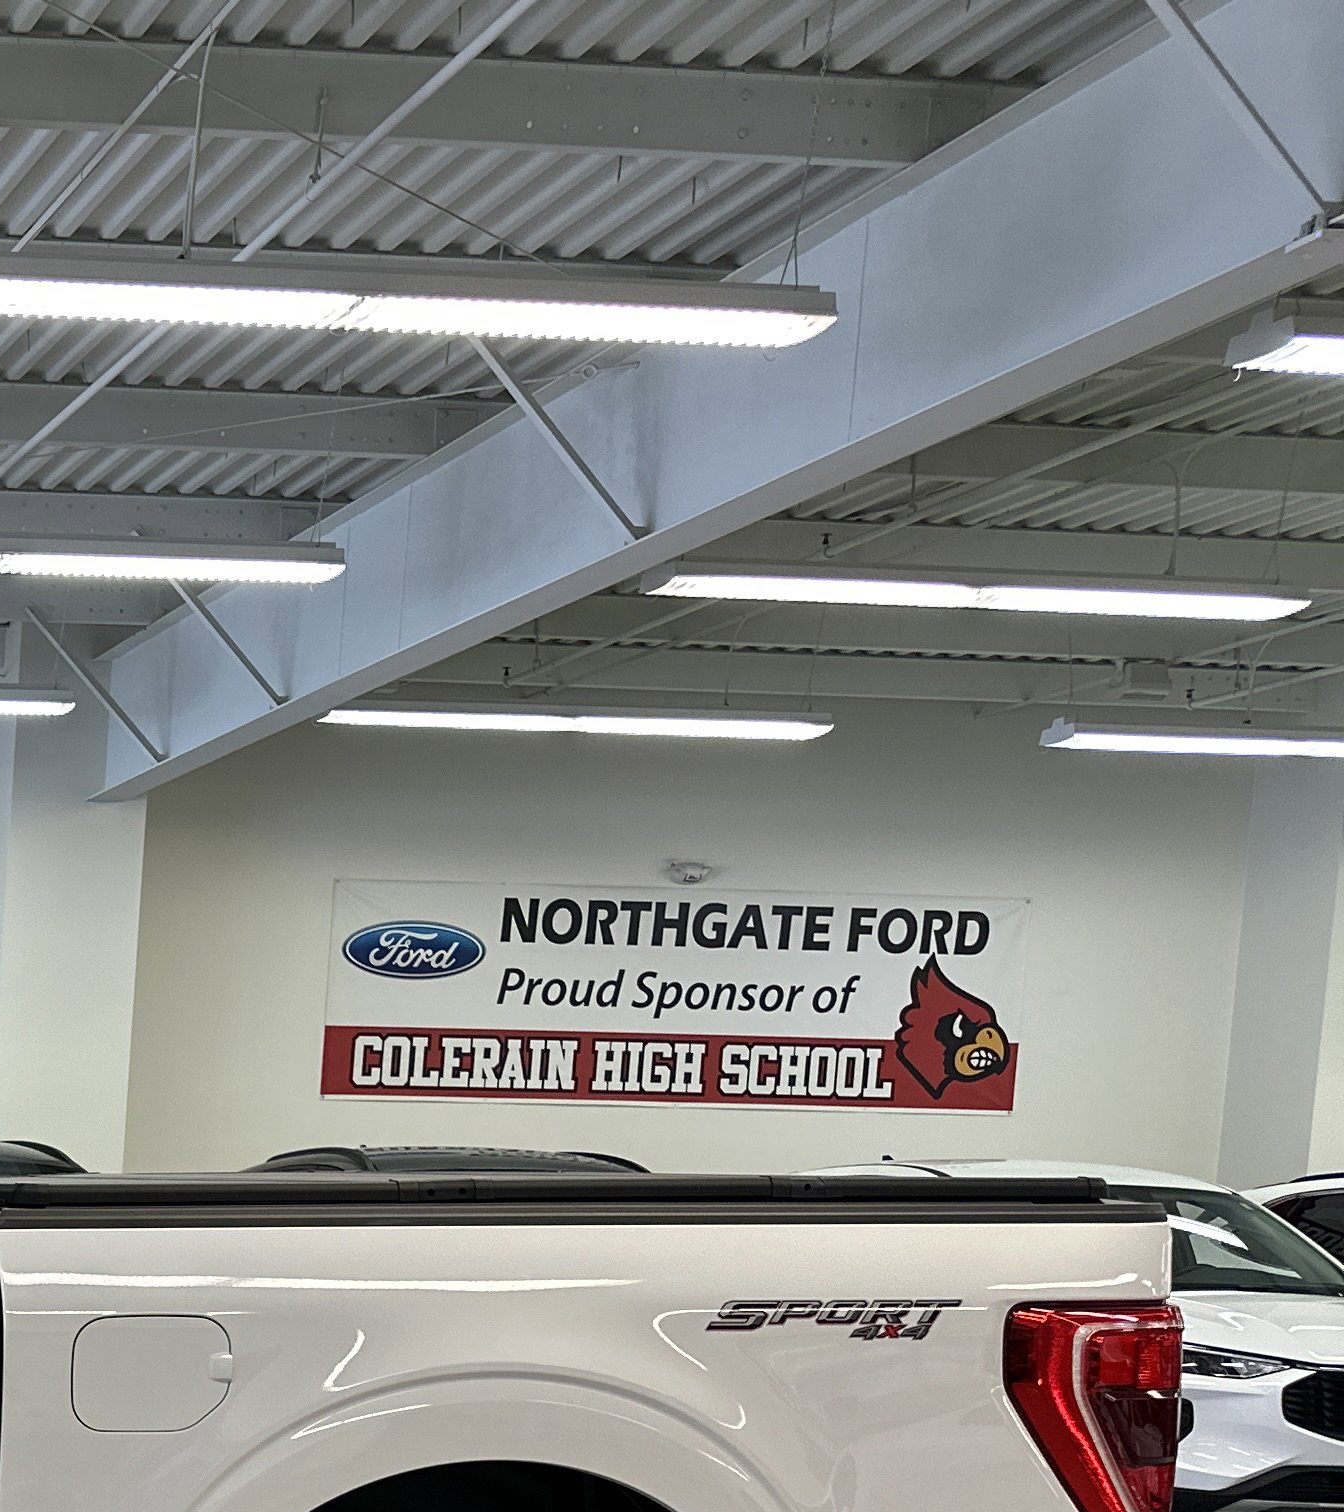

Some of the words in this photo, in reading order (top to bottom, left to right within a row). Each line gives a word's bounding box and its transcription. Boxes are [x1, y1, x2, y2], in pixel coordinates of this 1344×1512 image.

[368, 929, 460, 969] Ford
[500, 897, 834, 951] NORTHGATE
[846, 907, 990, 955] FORD
[496, 967, 626, 1007] Proud
[631, 970, 805, 1019] Sponsor
[811, 974, 861, 1014] of
[351, 1034, 579, 1092] COLERAIN
[590, 1039, 708, 1095] HIGH
[718, 1043, 894, 1099] SCHOOL
[705, 1299, 962, 1331] SPORT
[849, 1324, 931, 1341] 4x4
